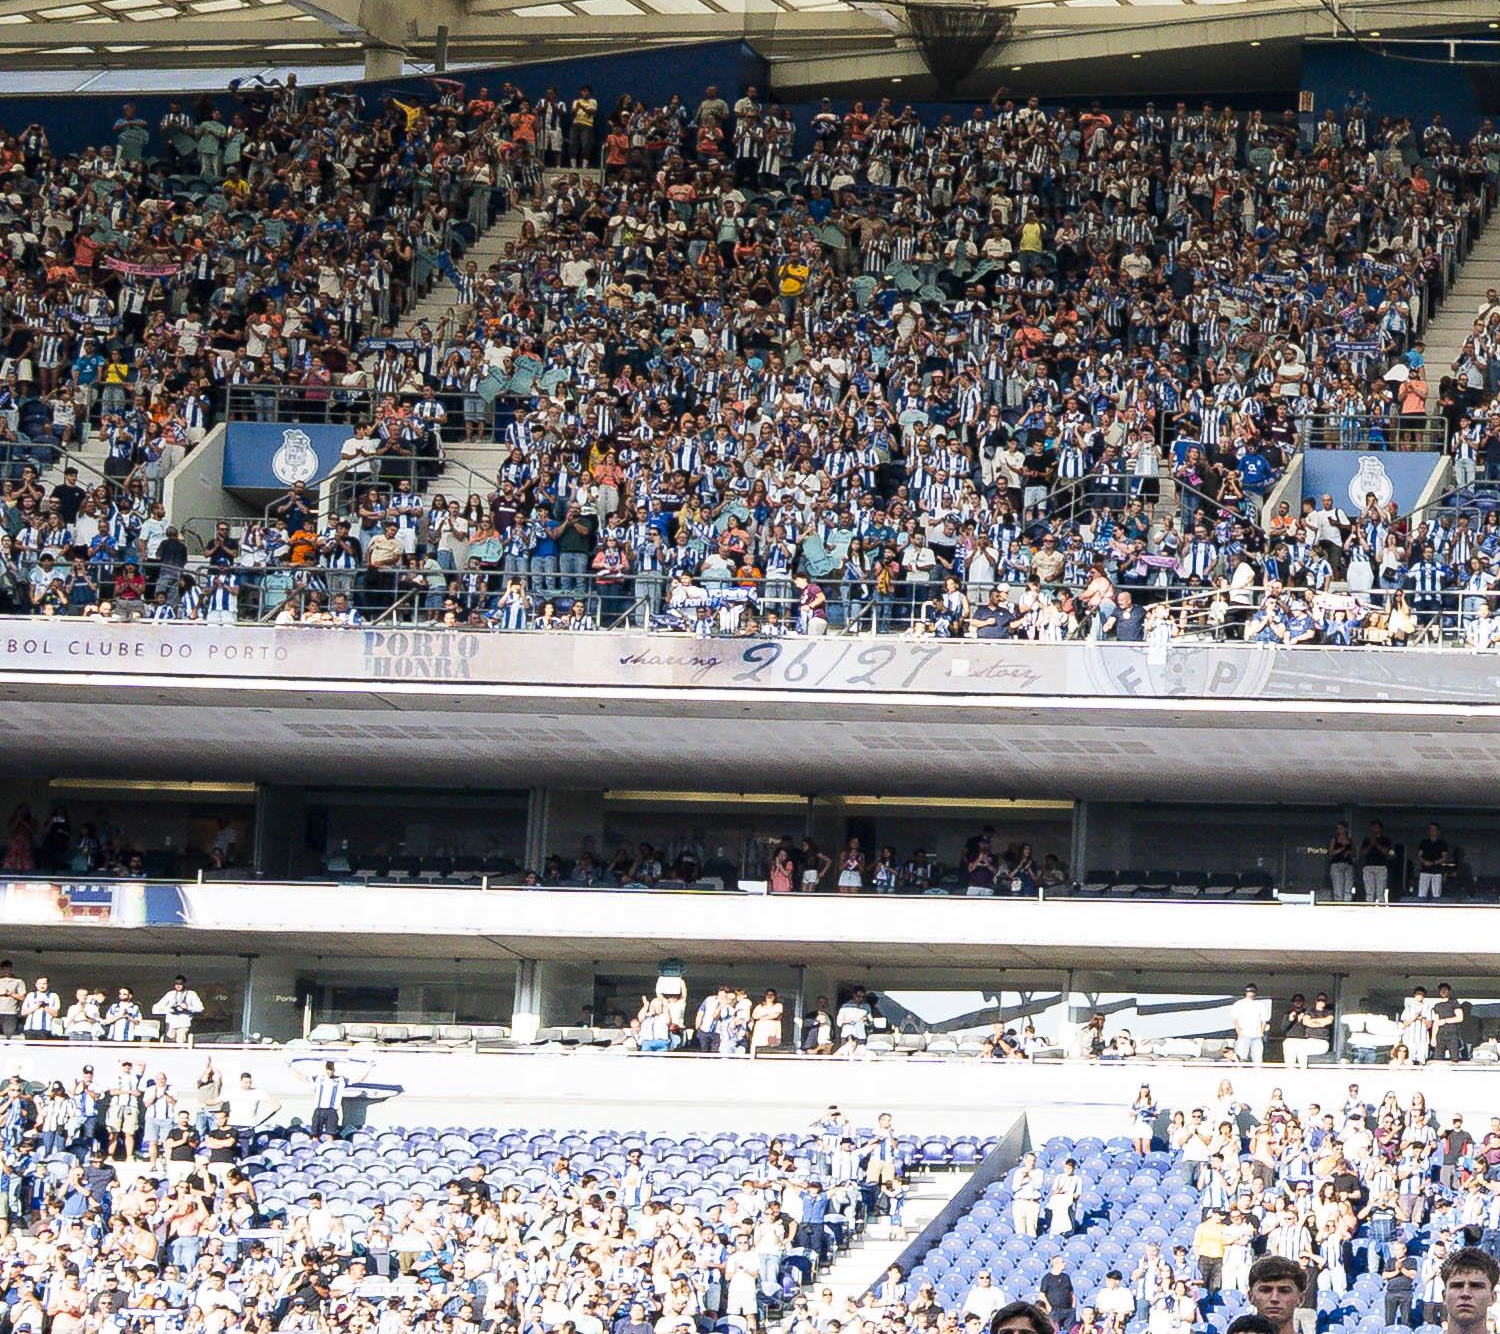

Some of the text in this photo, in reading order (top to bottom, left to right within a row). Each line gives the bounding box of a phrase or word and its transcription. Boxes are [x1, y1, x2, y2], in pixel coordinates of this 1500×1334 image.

[0, 637, 289, 661] BOL CLUBE DO PORTO
[363, 631, 480, 660] PORTO
[372, 656, 472, 679] HONRA
[619, 649, 722, 671] sharing
[734, 640, 943, 688] 26/27
